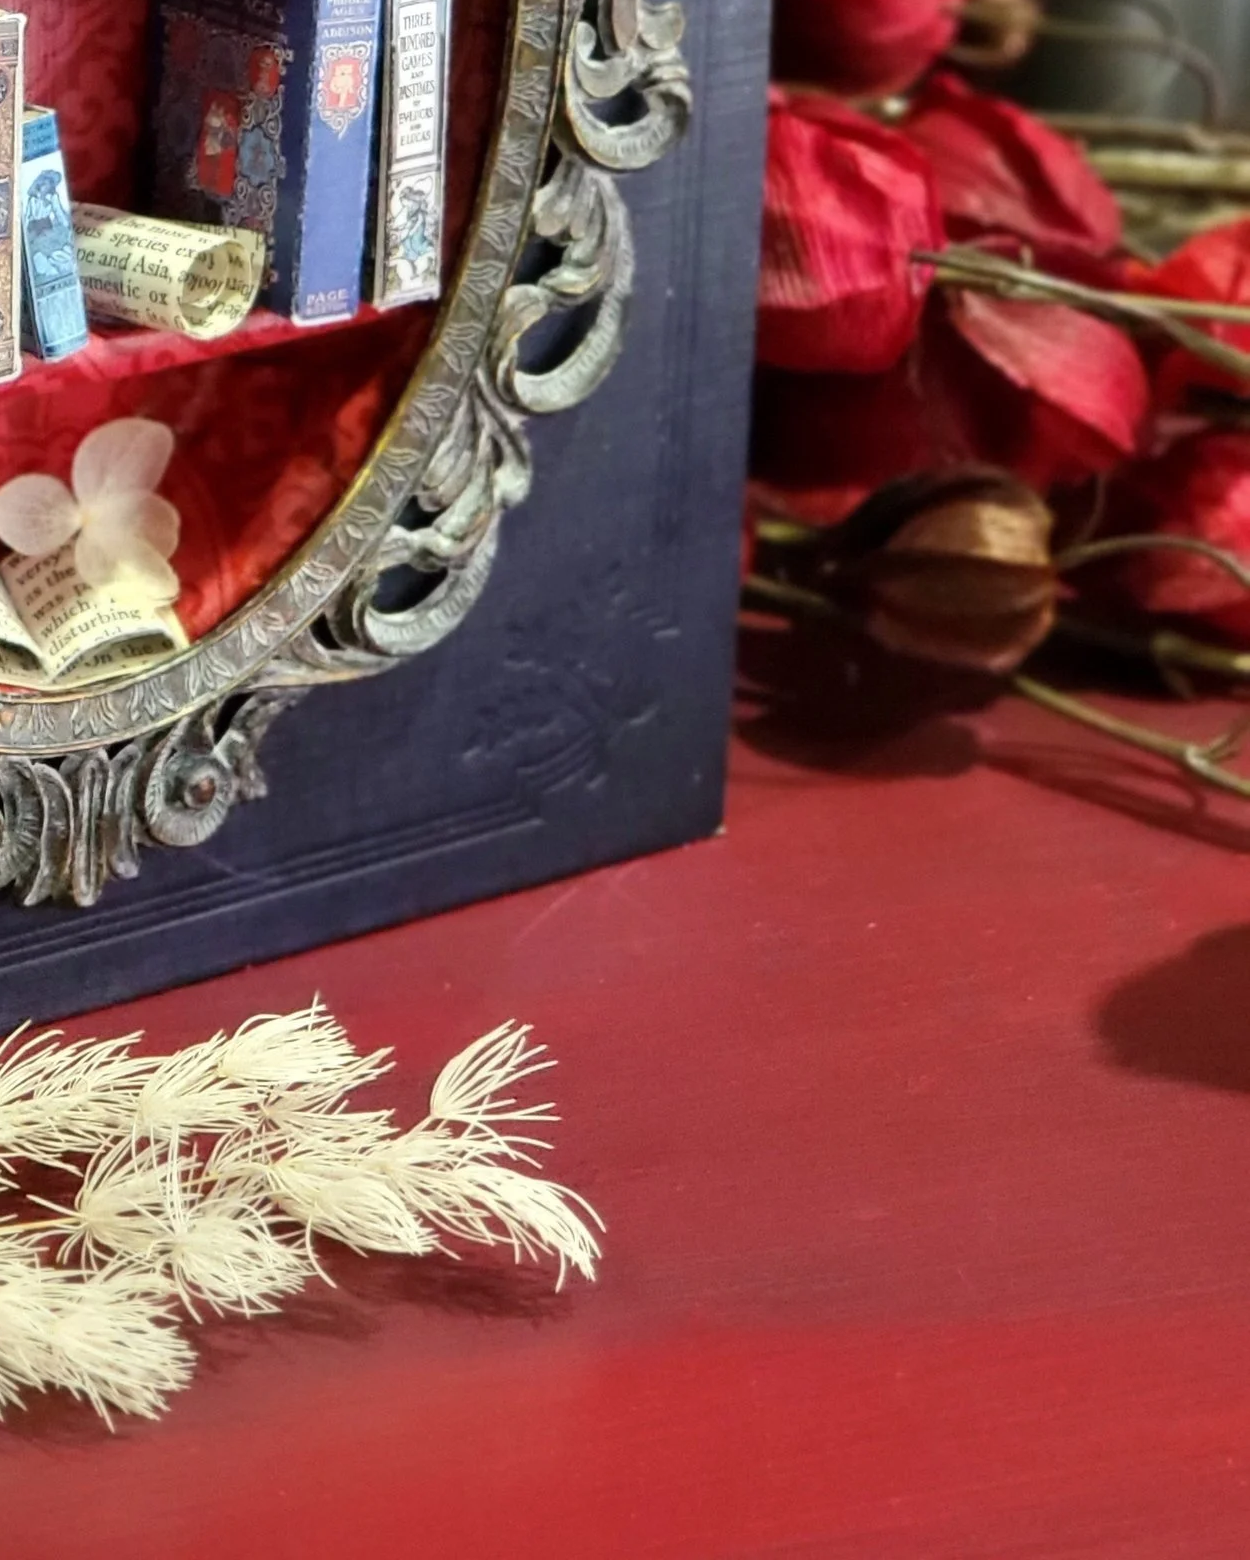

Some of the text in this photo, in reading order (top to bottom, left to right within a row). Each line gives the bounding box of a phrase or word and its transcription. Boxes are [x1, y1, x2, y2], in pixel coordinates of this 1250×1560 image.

[322, 25, 374, 38] ADDISON
[403, 12, 432, 30] THREE
[401, 52, 433, 72] GAMES
[110, 231, 171, 253] species
[98, 252, 132, 271] and
[133, 255, 173, 284] Asia,
[149, 290, 169, 306] ox
[307, 289, 348, 305] PAGE
[46, 566, 77, 587] the
[32, 593, 65, 621] was
[39, 597, 99, 640] which,
[48, 606, 143, 657] disturbing
